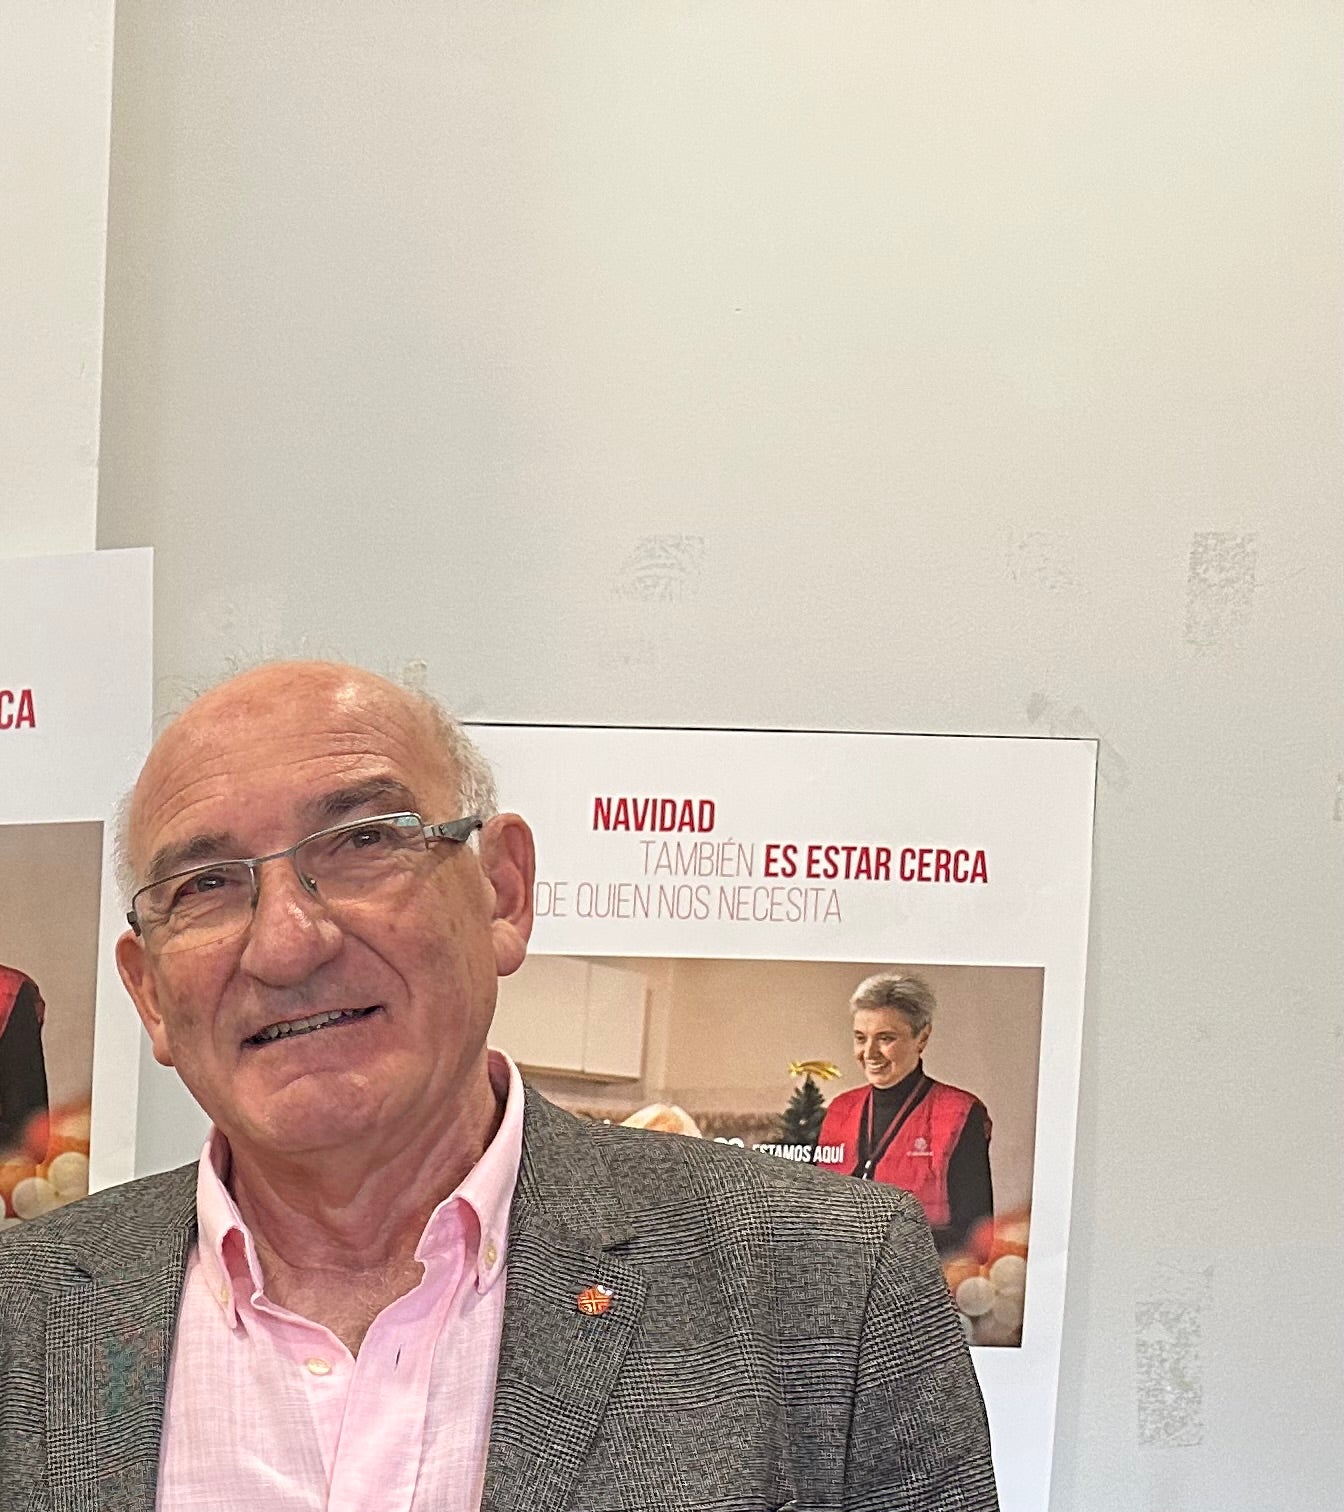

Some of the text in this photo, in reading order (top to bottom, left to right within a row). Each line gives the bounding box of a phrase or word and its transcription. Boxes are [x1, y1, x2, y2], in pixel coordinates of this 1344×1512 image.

[592, 797, 716, 834] NAVIDAD
[640, 837, 989, 884] TAMBIÉN ES ESTAR CERCA
[535, 881, 843, 924] DE QUIEN NOS NECESITA
[813, 1142, 845, 1163] AQUÍ
